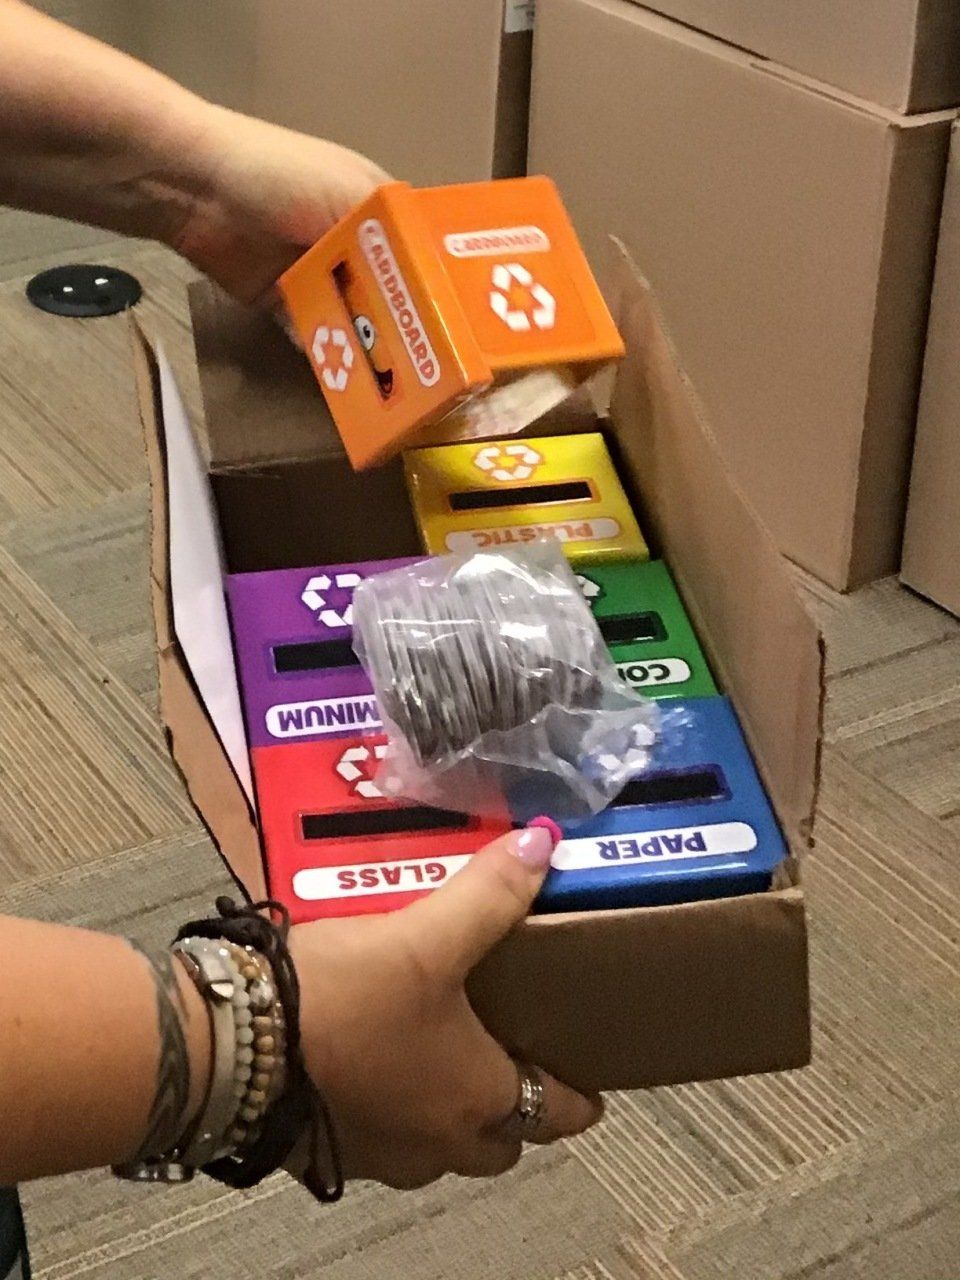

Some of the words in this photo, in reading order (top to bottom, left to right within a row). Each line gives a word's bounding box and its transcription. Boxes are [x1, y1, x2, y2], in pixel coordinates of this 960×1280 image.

[365, 225, 436, 380] ARDBOARD
[277, 700, 382, 732] MINUM
[596, 831, 708, 861] PAPER
[337, 862, 447, 890] GLASS
